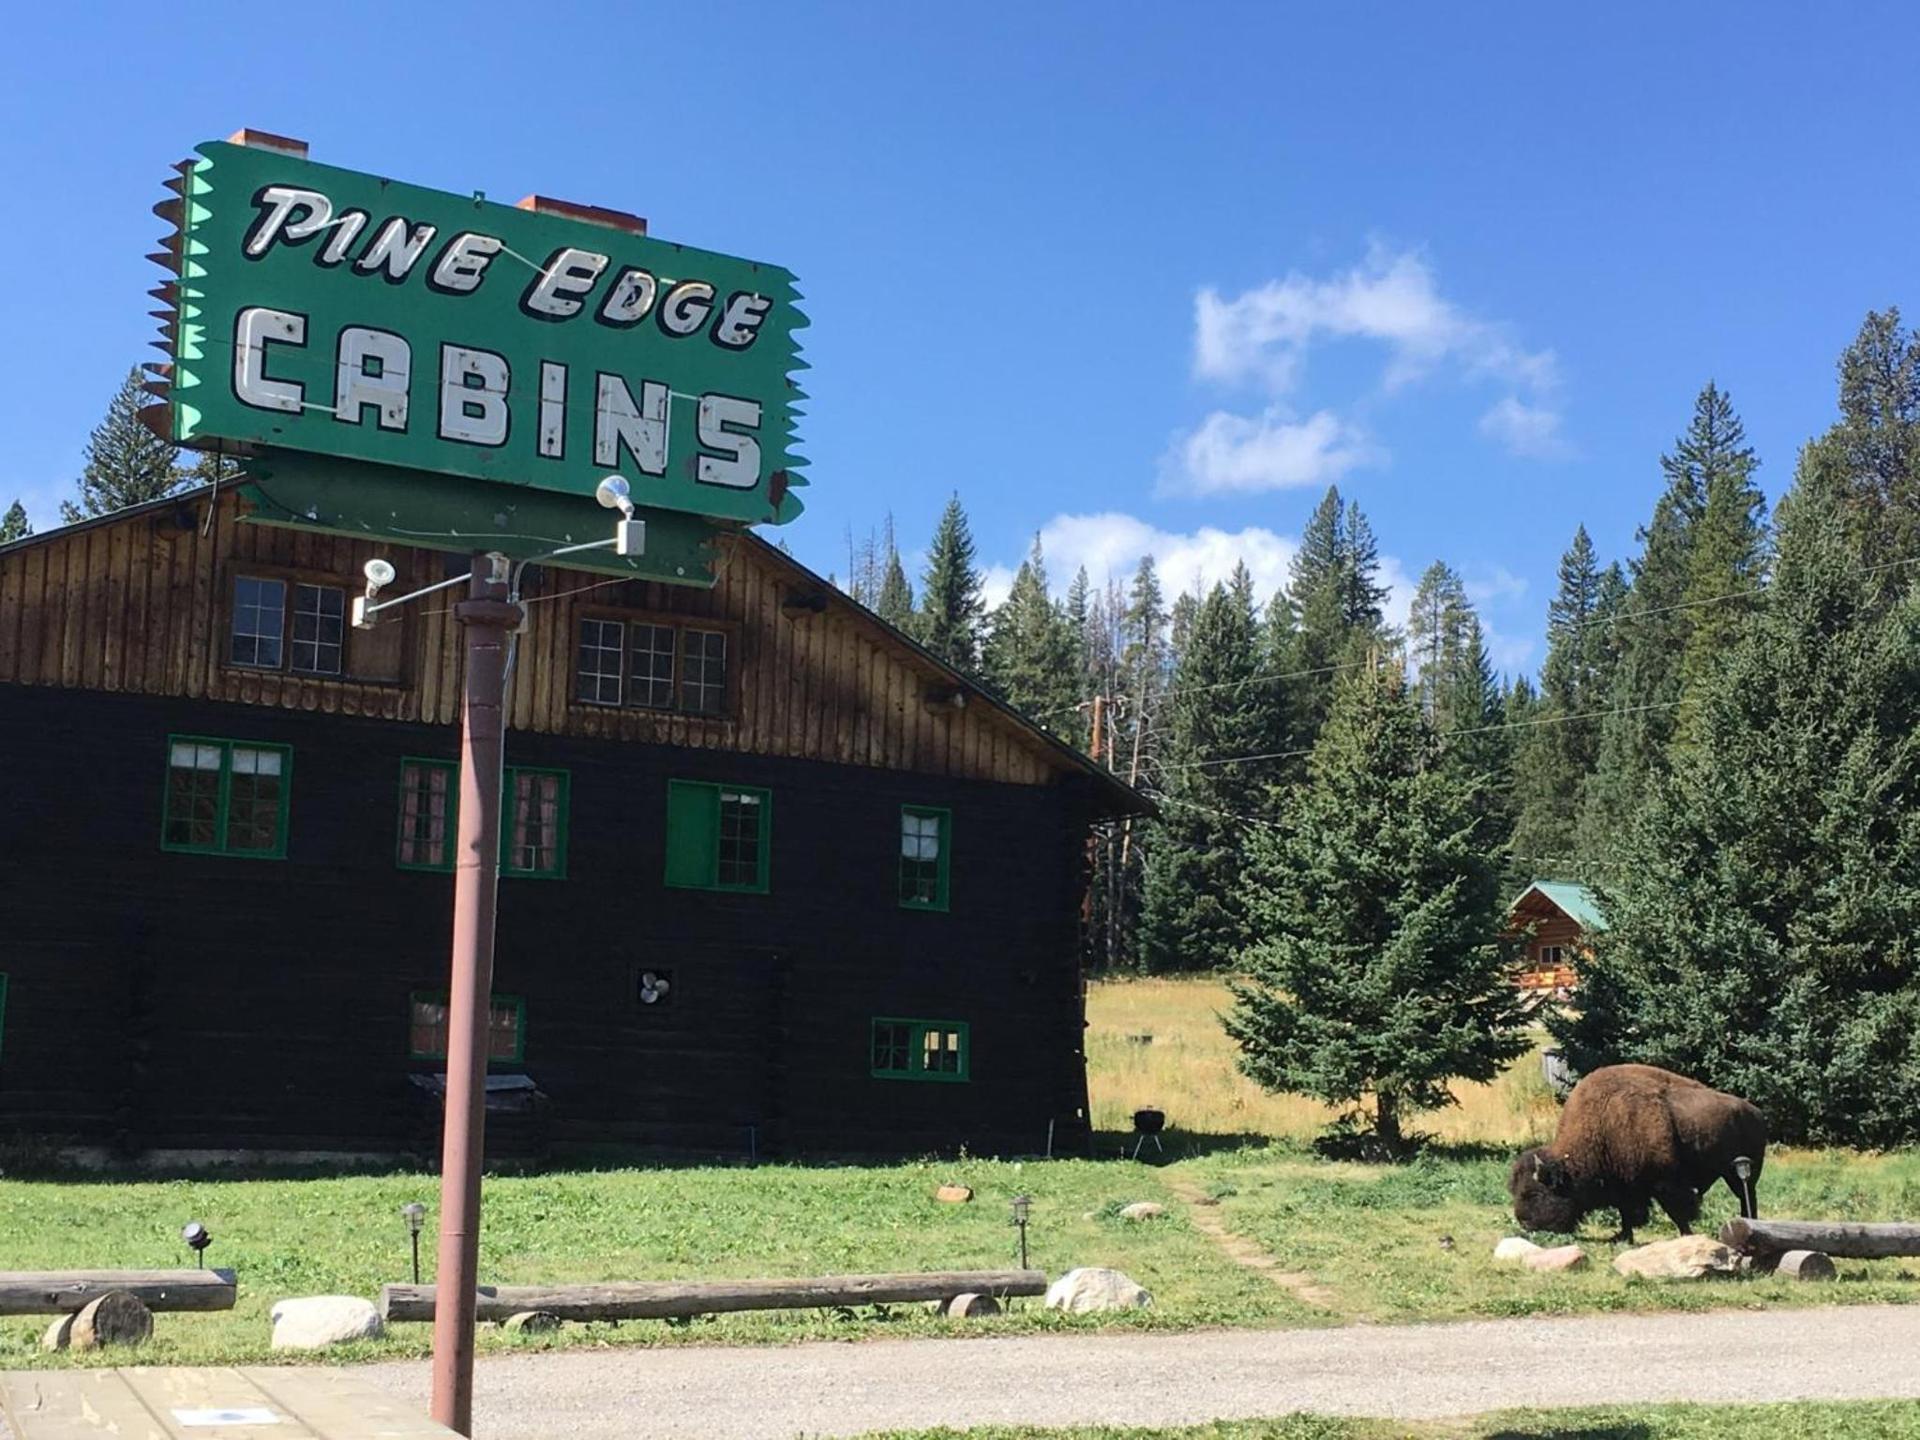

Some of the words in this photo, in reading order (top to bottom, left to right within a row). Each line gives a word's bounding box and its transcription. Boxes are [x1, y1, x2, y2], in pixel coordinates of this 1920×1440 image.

[245, 185, 503, 292] PINE
[525, 246, 772, 347] EDGE
[234, 307, 763, 489] CABINS
